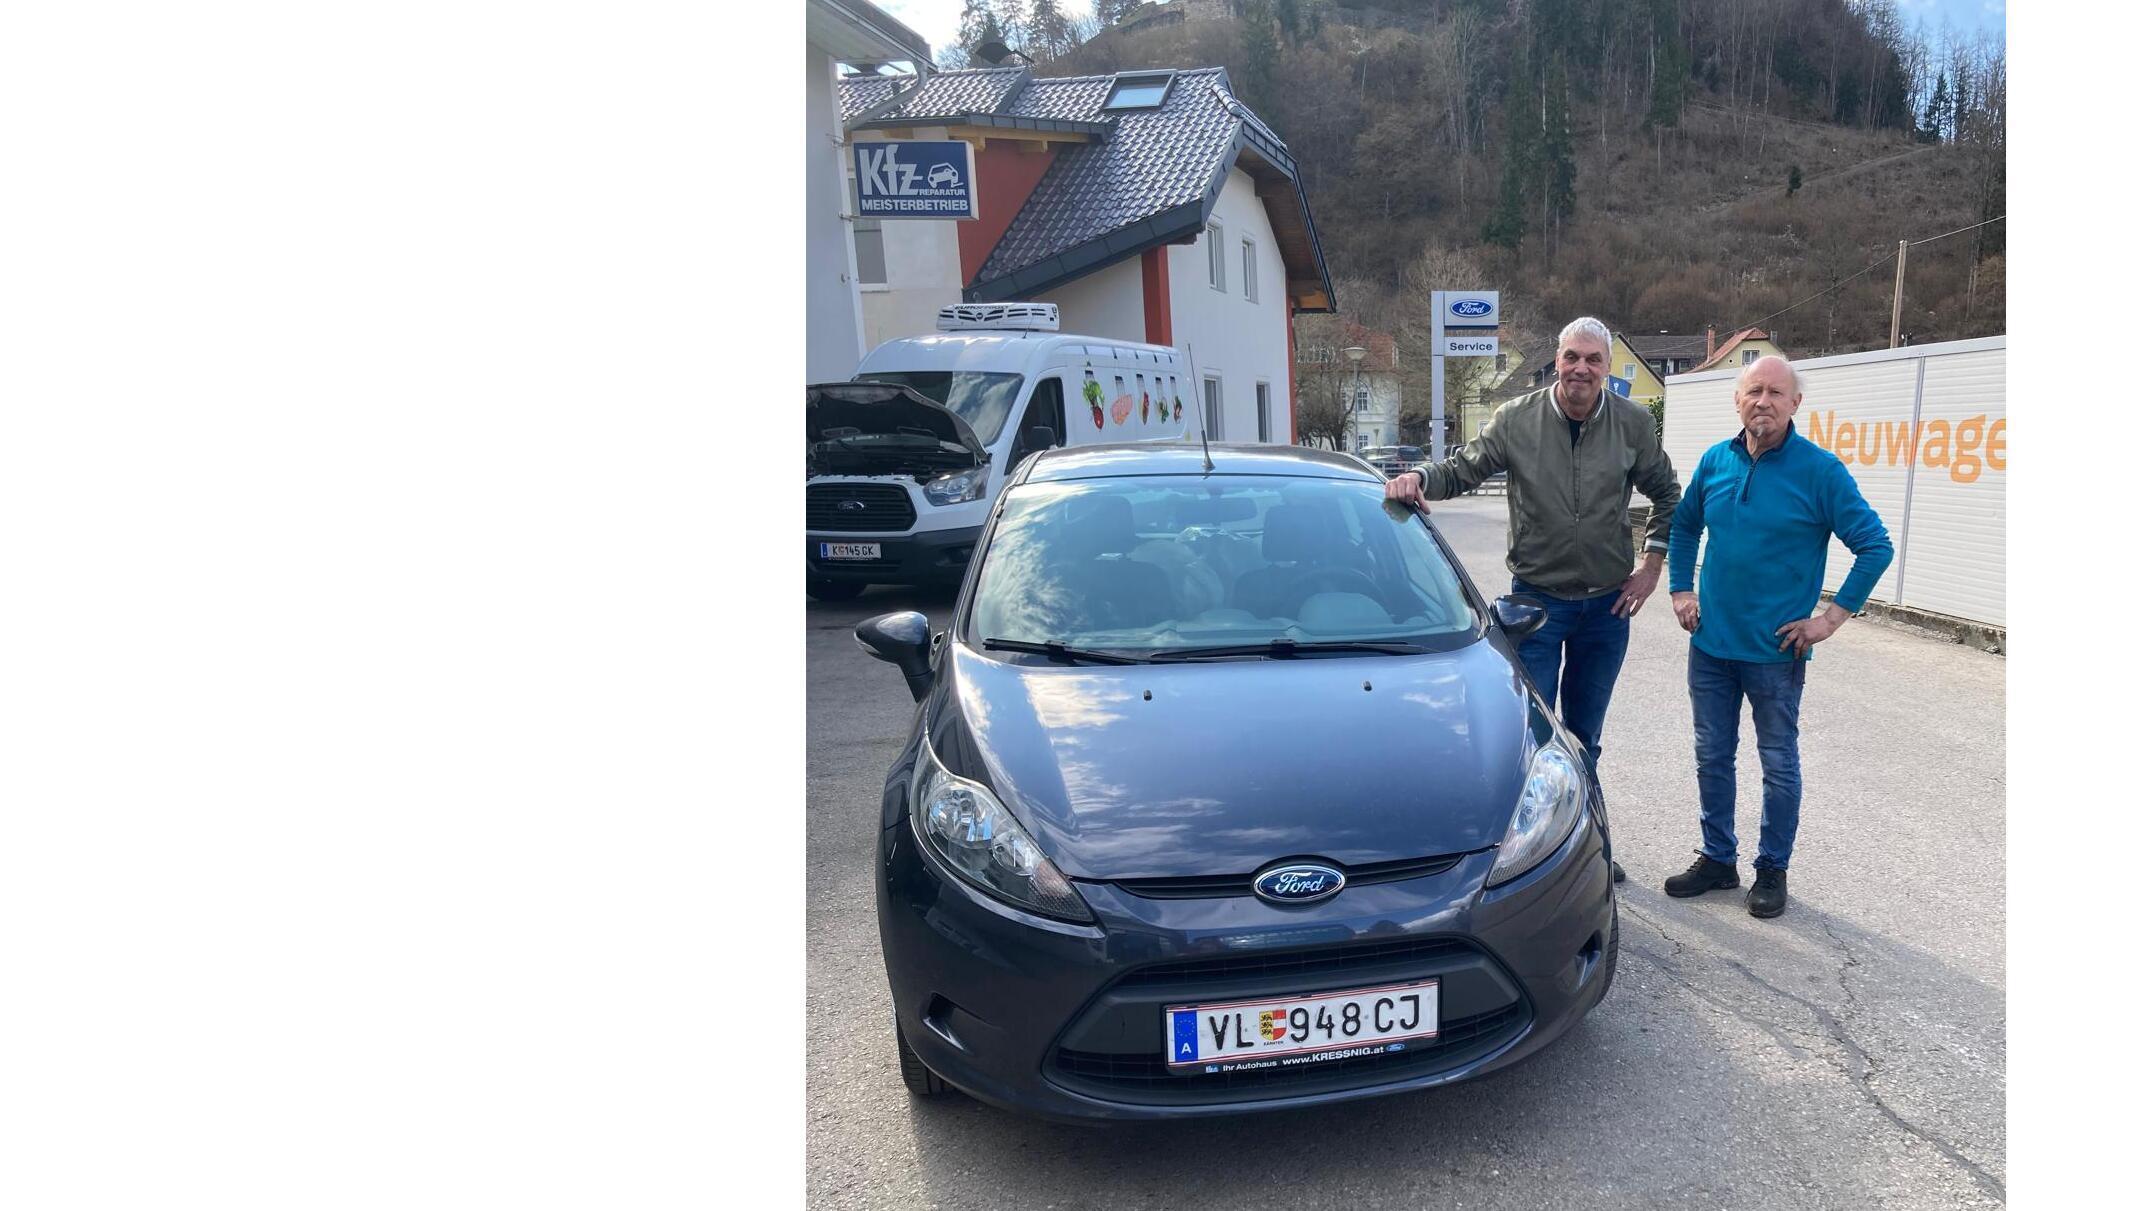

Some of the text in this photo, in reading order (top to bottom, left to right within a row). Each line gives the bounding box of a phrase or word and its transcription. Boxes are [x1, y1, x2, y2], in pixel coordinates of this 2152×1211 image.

[861, 199, 969, 211] MEISTERBETRIEB
[1450, 342, 1493, 351] Service
[845, 545, 860, 556] 145
[1274, 871, 1325, 894] Ford
[1208, 994, 1420, 1051] VL 948 CJ
[1181, 1043, 1192, 1054] A
[1222, 1064, 1235, 1072] Ihr
[1236, 1060, 1278, 1071] Autohaus
[1282, 1046, 1384, 1065] www.KRESSNIG.at
